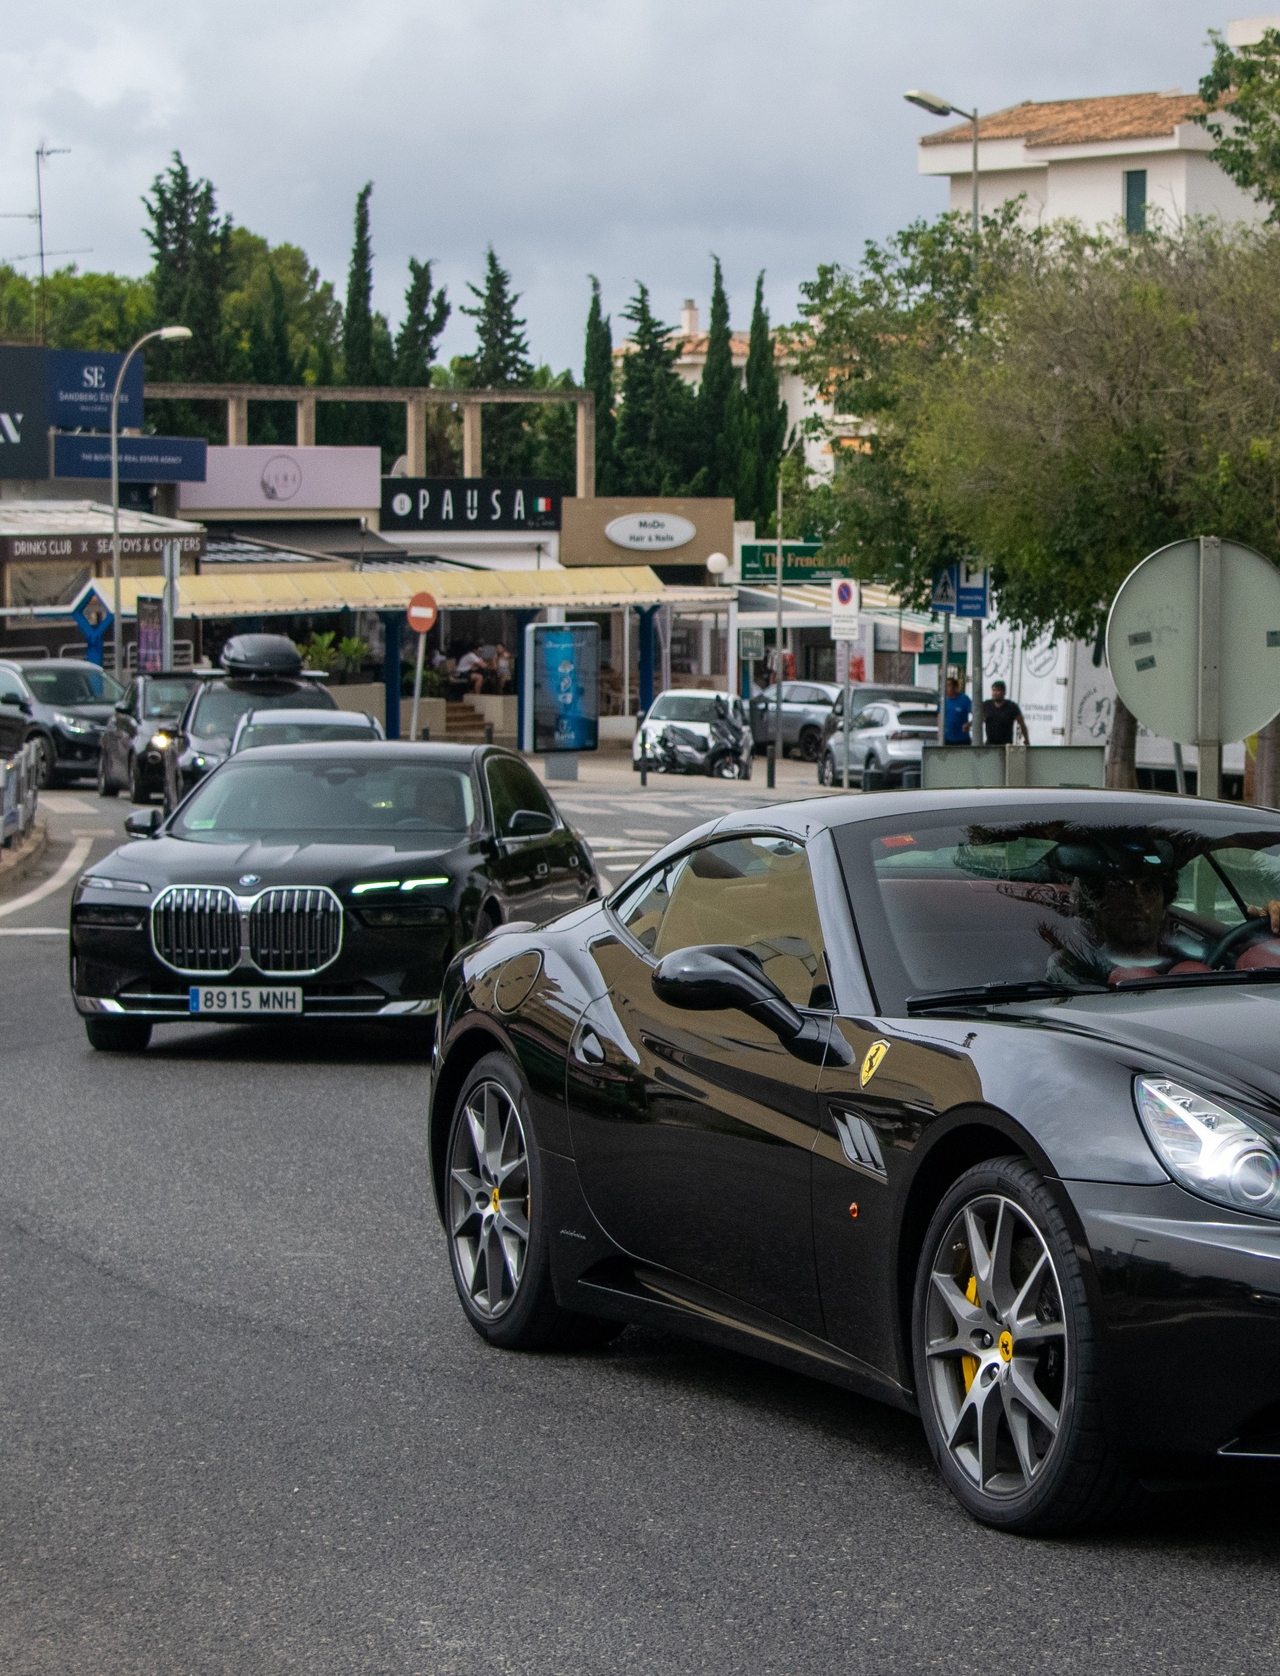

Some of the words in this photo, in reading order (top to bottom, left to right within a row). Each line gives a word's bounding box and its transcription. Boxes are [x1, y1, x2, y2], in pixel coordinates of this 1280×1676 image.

[83, 366, 106, 388] SE
[59, 390, 98, 403] SANDBERG
[81, 452, 92, 461] THE
[418, 489, 526, 521] PAUSA
[14, 541, 47, 556] DRINKS
[50, 540, 72, 554] CLUB
[97, 539, 115, 553] SEA
[143, 538, 150, 552] &
[629, 534, 645, 542] Hair
[204, 991, 252, 1009] 8915
[259, 991, 296, 1009] MNH
